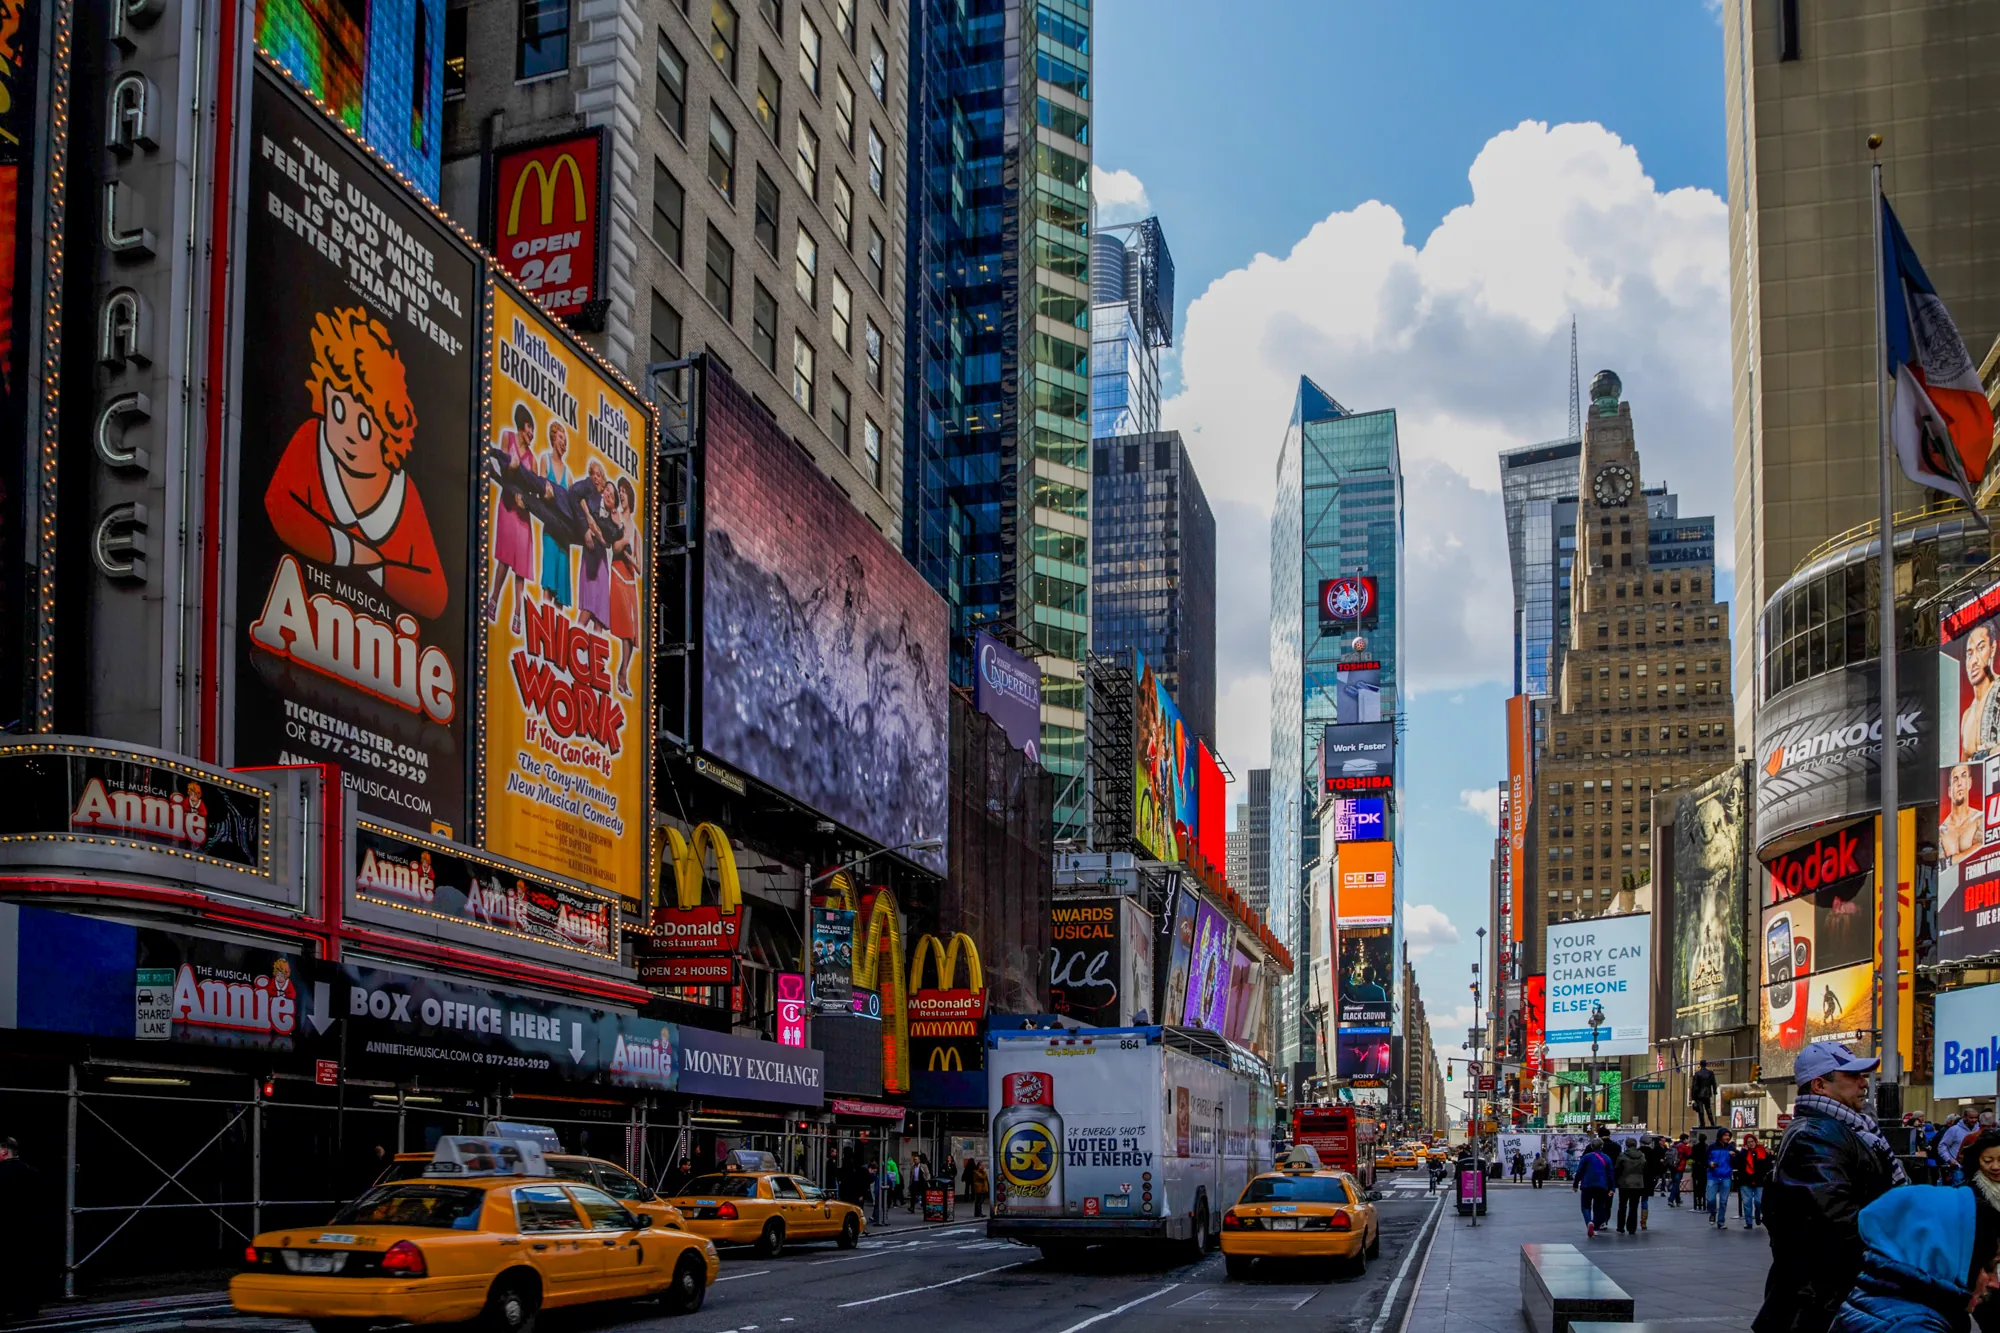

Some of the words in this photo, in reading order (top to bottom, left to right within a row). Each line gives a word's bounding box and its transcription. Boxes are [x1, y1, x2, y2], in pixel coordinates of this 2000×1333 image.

[262, 135, 380, 248] FEEL-GOOD
[386, 240, 463, 319] MUSICAL
[347, 182, 435, 273] ULTIMATE
[268, 191, 343, 269] BETTER
[348, 255, 402, 314] THAN
[304, 195, 324, 228] IS
[331, 218, 385, 277] BACK
[389, 271, 431, 313] AND
[511, 230, 582, 259] OPEN
[520, 254, 572, 290] 24
[364, 292, 394, 321] MAGAZINE
[537, 285, 589, 309] URS
[513, 316, 568, 387] Matthew
[499, 340, 580, 432] BRODERICK
[598, 393, 631, 442] Jessie
[588, 414, 640, 480] MUELLER
[306, 564, 332, 590] THE
[336, 583, 393, 620] MUSICAL
[249, 553, 457, 726] Annie
[523, 595, 612, 695] NICE
[981, 644, 1040, 706] CINDERELLA
[1338, 662, 1380, 672] TOSHIBA
[511, 650, 625, 756] WORK
[284, 699, 430, 769] TICKETMASTER.COM
[526, 719, 537, 742] If
[538, 726, 560, 755] You
[560, 742, 581, 766] Can
[582, 745, 601, 770] Get
[602, 755, 612, 778] It
[1333, 744, 1356, 752] Work
[1358, 742, 1386, 752] Faster
[286, 721, 307, 742] OR
[310, 729, 428, 785] 877-250-2929
[1798, 750, 1844, 775] driving
[1846, 735, 1920, 761] emoon
[107, 778, 125, 791] THE
[128, 782, 168, 798] MUSICAL
[518, 752, 542, 776] The
[544, 760, 618, 812] Tony-Winning
[1326, 775, 1393, 791] TOSHIBA
[71, 777, 208, 845] Annie
[506, 772, 536, 799] New
[536, 784, 580, 816] Musical
[583, 802, 624, 836] Comedy
[1513, 774, 1522, 831] REUTERS
[1356, 812, 1380, 824] TDK
[376, 850, 387, 861] THE
[388, 854, 409, 866] MUSICAL
[1768, 829, 1860, 904] Kodak
[1966, 862, 1987, 882] FRANK
[356, 848, 435, 904] Annie
[464, 878, 528, 926] Annie
[653, 920, 736, 936] cDonald's
[1052, 925, 1114, 940] USICAL
[1976, 912, 1991, 928] LIVE
[653, 936, 718, 948] Restaurant
[1552, 934, 1596, 950] YOUR
[1552, 949, 1604, 966] STORY
[1608, 946, 1642, 961] CAN
[136, 972, 150, 983] BIKE
[152, 972, 172, 983] ROUTE
[196, 965, 213, 978] THE
[214, 968, 252, 983] MUSICAL
[641, 965, 672, 978] OPEN
[674, 965, 688, 978] 24
[690, 965, 728, 977] HOURS
[1552, 964, 1618, 982] CHANGE
[171, 962, 298, 1035] Annie
[1552, 980, 1628, 997] SOMEONE
[137, 1008, 170, 1021] SHARED
[350, 986, 412, 1022] BOX
[420, 998, 502, 1035] OFFICE
[510, 1010, 561, 1042] HERE
[908, 997, 982, 1010] McDonald's
[920, 1008, 968, 1018] Restaurant
[1342, 1012, 1362, 1020] BLACK
[1362, 1012, 1386, 1020] CROWN
[143, 1022, 166, 1034] LANE
[366, 1040, 470, 1064] ANNIETHEMUSICAL.COM
[472, 1052, 484, 1064] OR
[486, 1054, 550, 1070] 877-250-2929
[609, 1032, 673, 1078] Annie
[1120, 1039, 1139, 1050] 864
[684, 1048, 743, 1079] MONEY
[746, 1057, 820, 1088] EXCHANGE
[1638, 1082, 1662, 1090] Broadway
[1068, 1128, 1080, 1136] SK
[1081, 1126, 1116, 1137] ENERGY
[1118, 1126, 1147, 1136] SHOTS
[1068, 1138, 1117, 1152] VOTED
[1122, 1138, 1140, 1151] #1
[1502, 1138, 1522, 1148] Long
[1010, 1140, 1048, 1172] SK
[1068, 1152, 1090, 1167] IN
[1092, 1152, 1153, 1168] ENERGY
[1006, 1184, 1052, 1198] ENERGY
